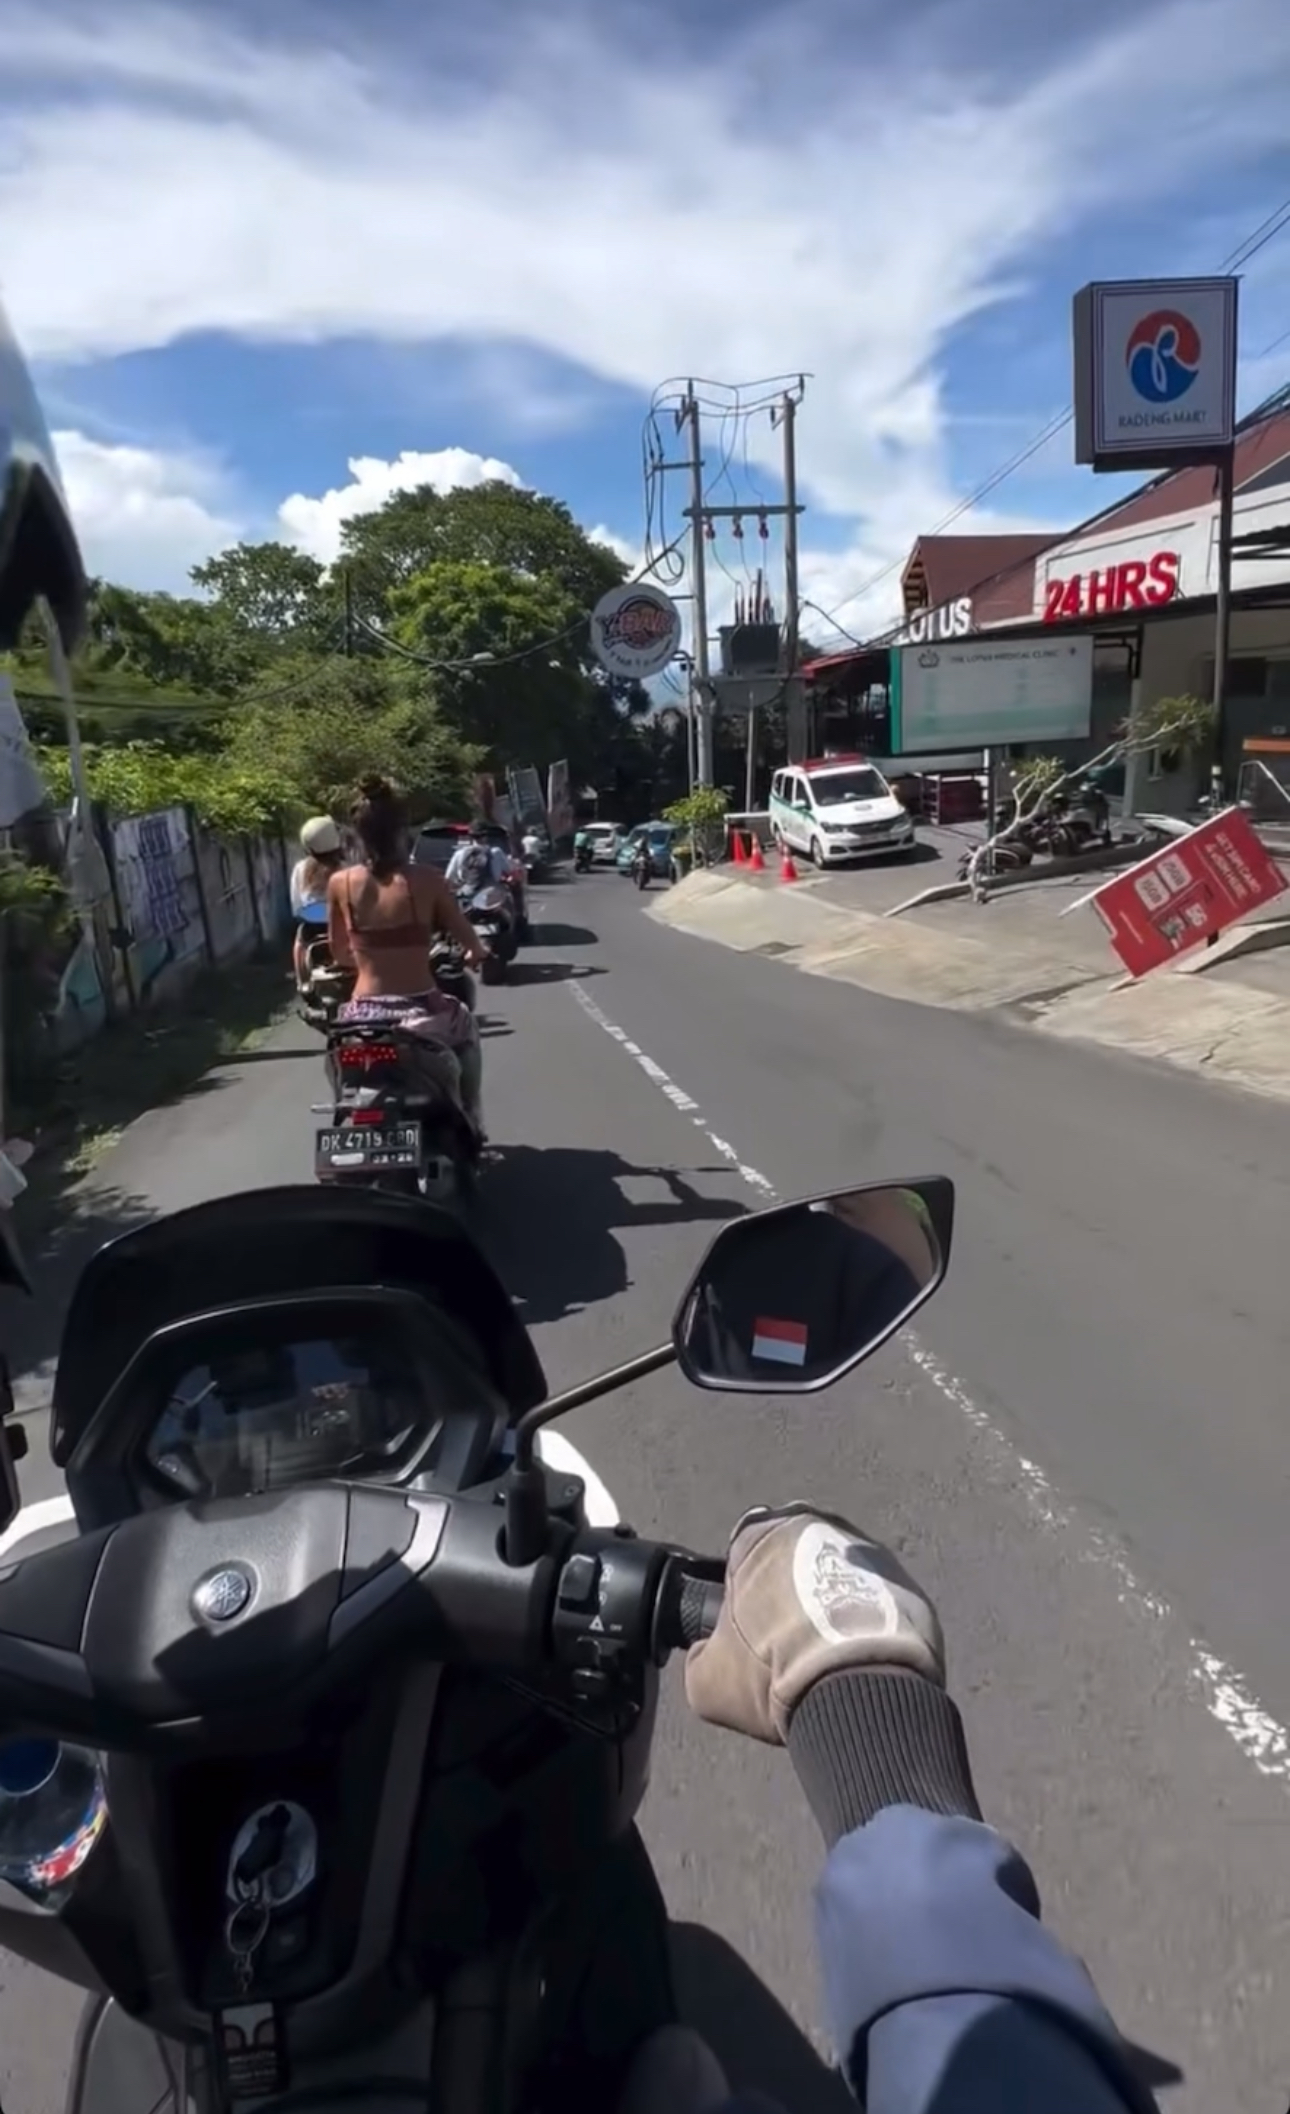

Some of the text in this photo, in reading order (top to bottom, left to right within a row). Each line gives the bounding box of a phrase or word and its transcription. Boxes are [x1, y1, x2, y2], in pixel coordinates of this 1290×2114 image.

[1043, 551, 1179, 625] 24 HRS
[321, 1134, 341, 1151] DK
